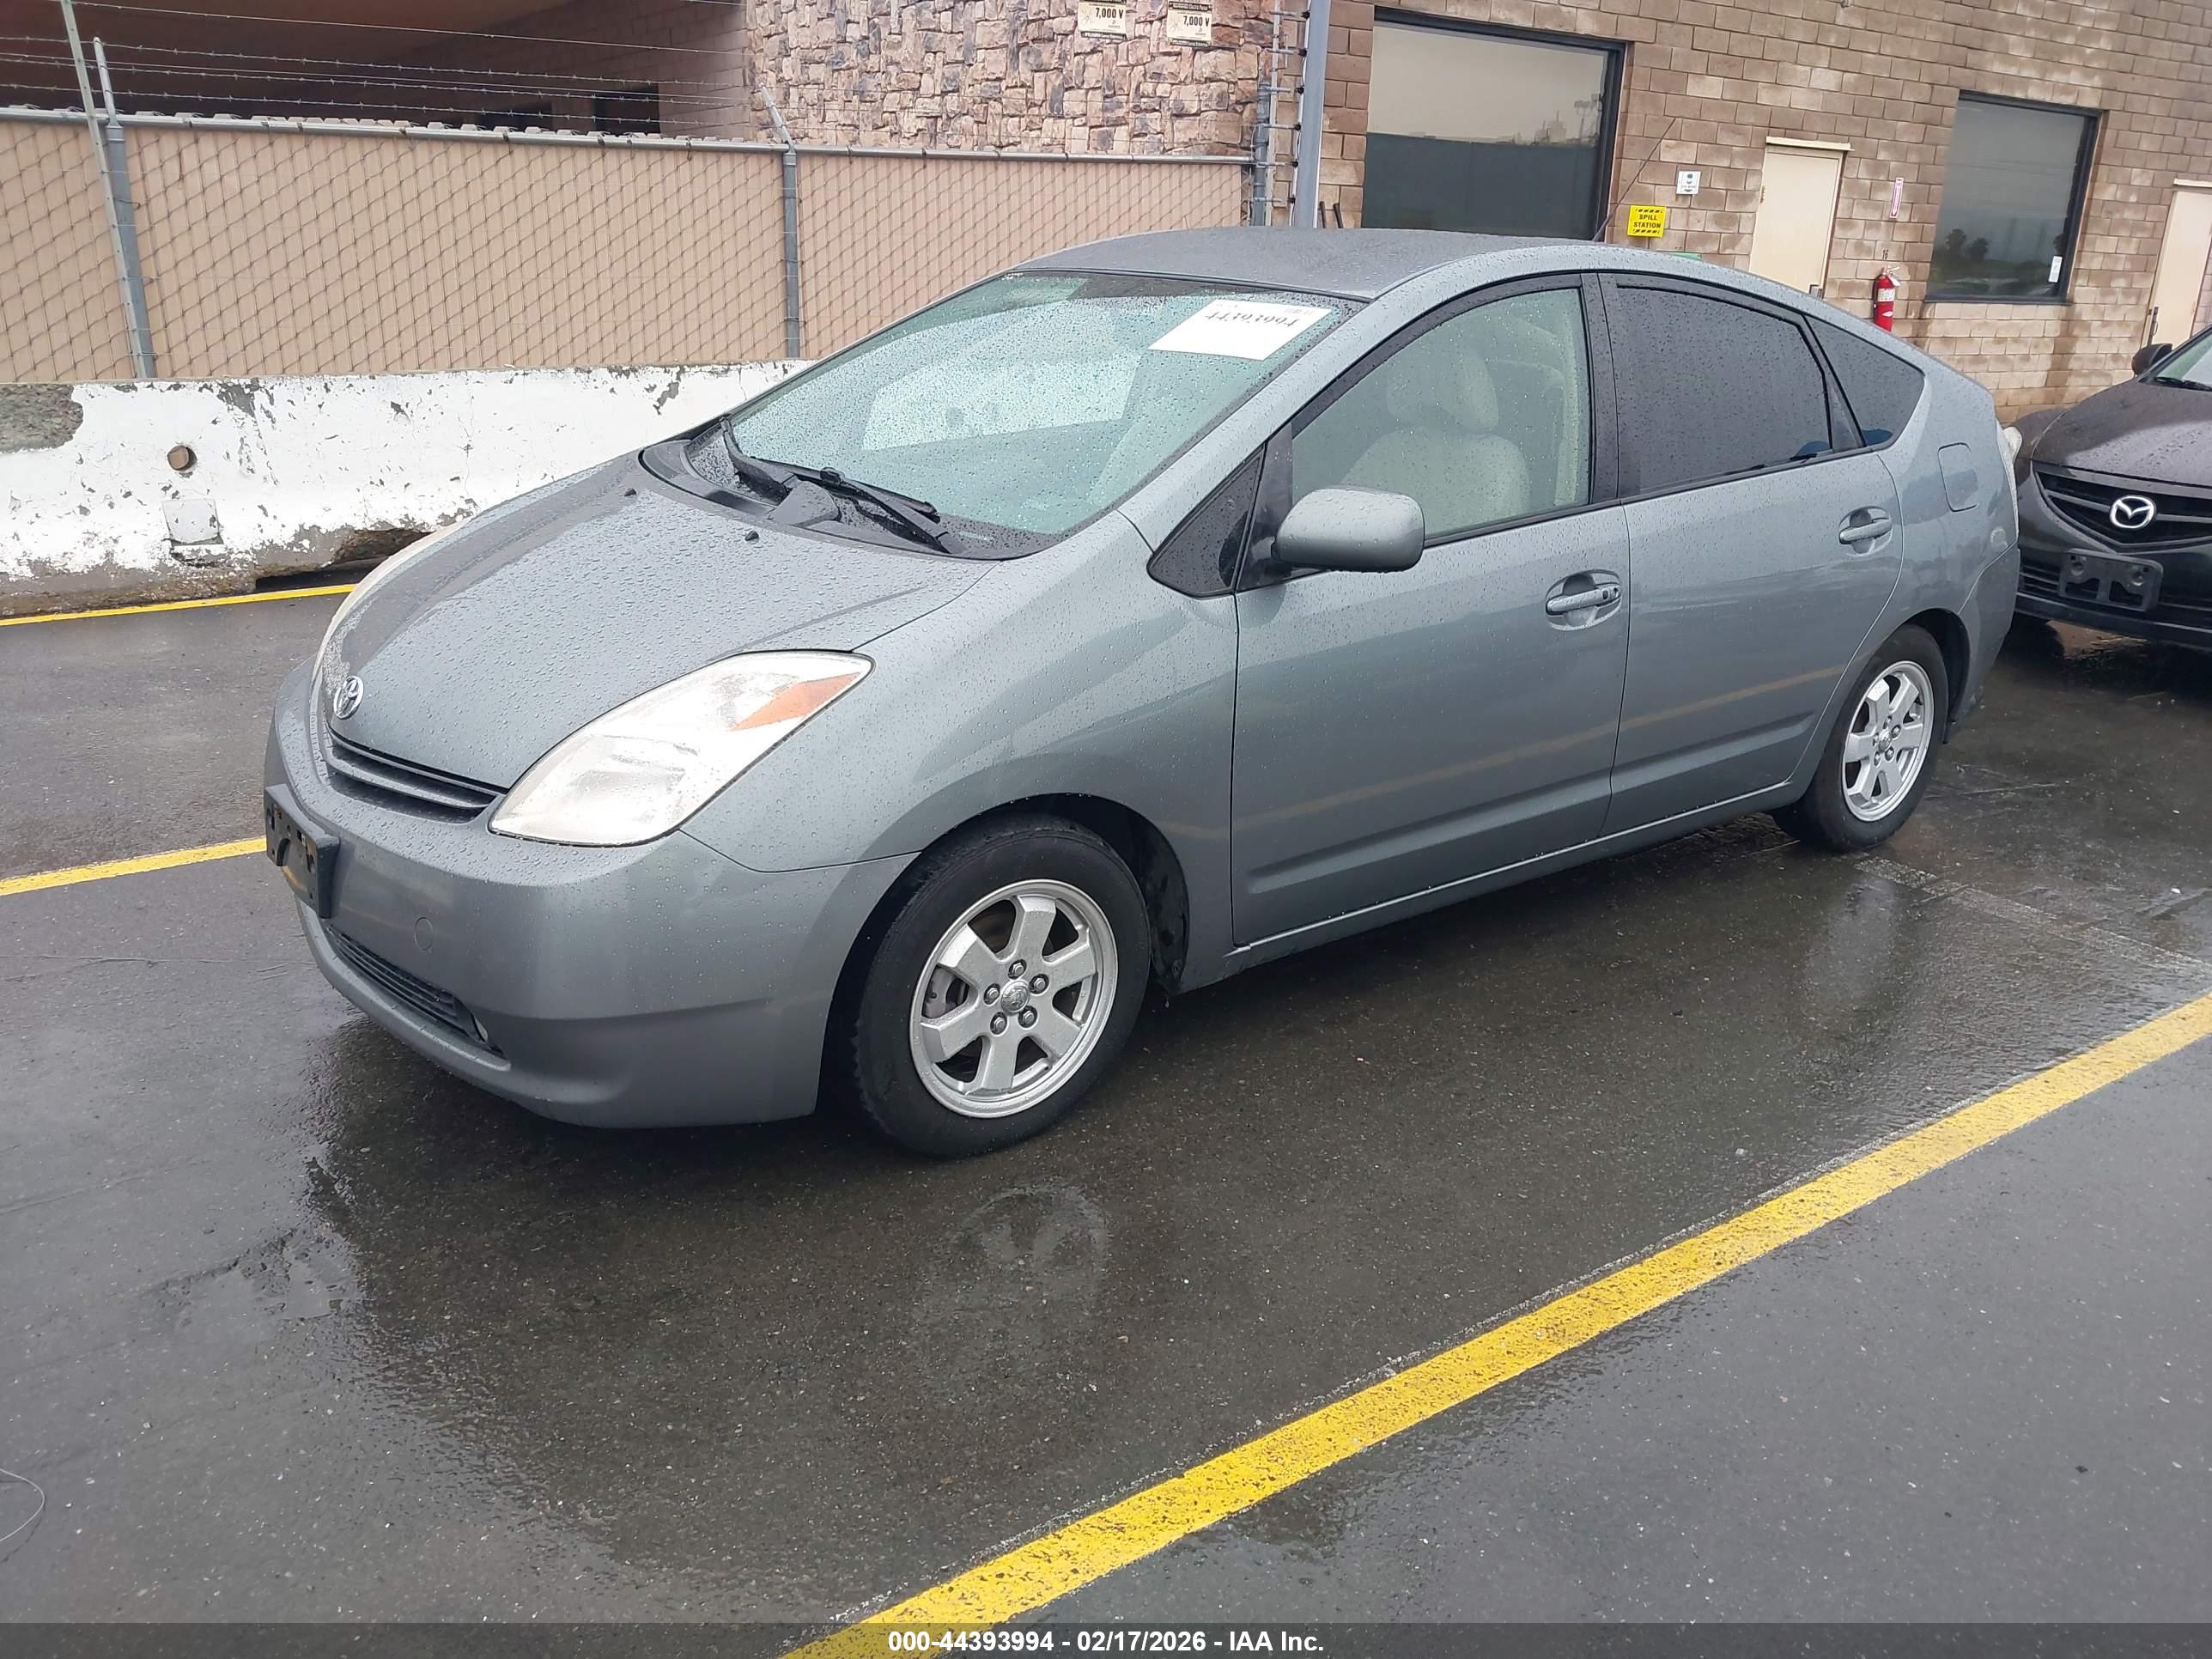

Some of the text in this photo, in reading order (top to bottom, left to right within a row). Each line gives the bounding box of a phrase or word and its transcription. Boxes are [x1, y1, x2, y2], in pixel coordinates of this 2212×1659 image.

[1096, 7, 1124, 19] 7,000 V
[1183, 15, 1210, 27] 7,000 V
